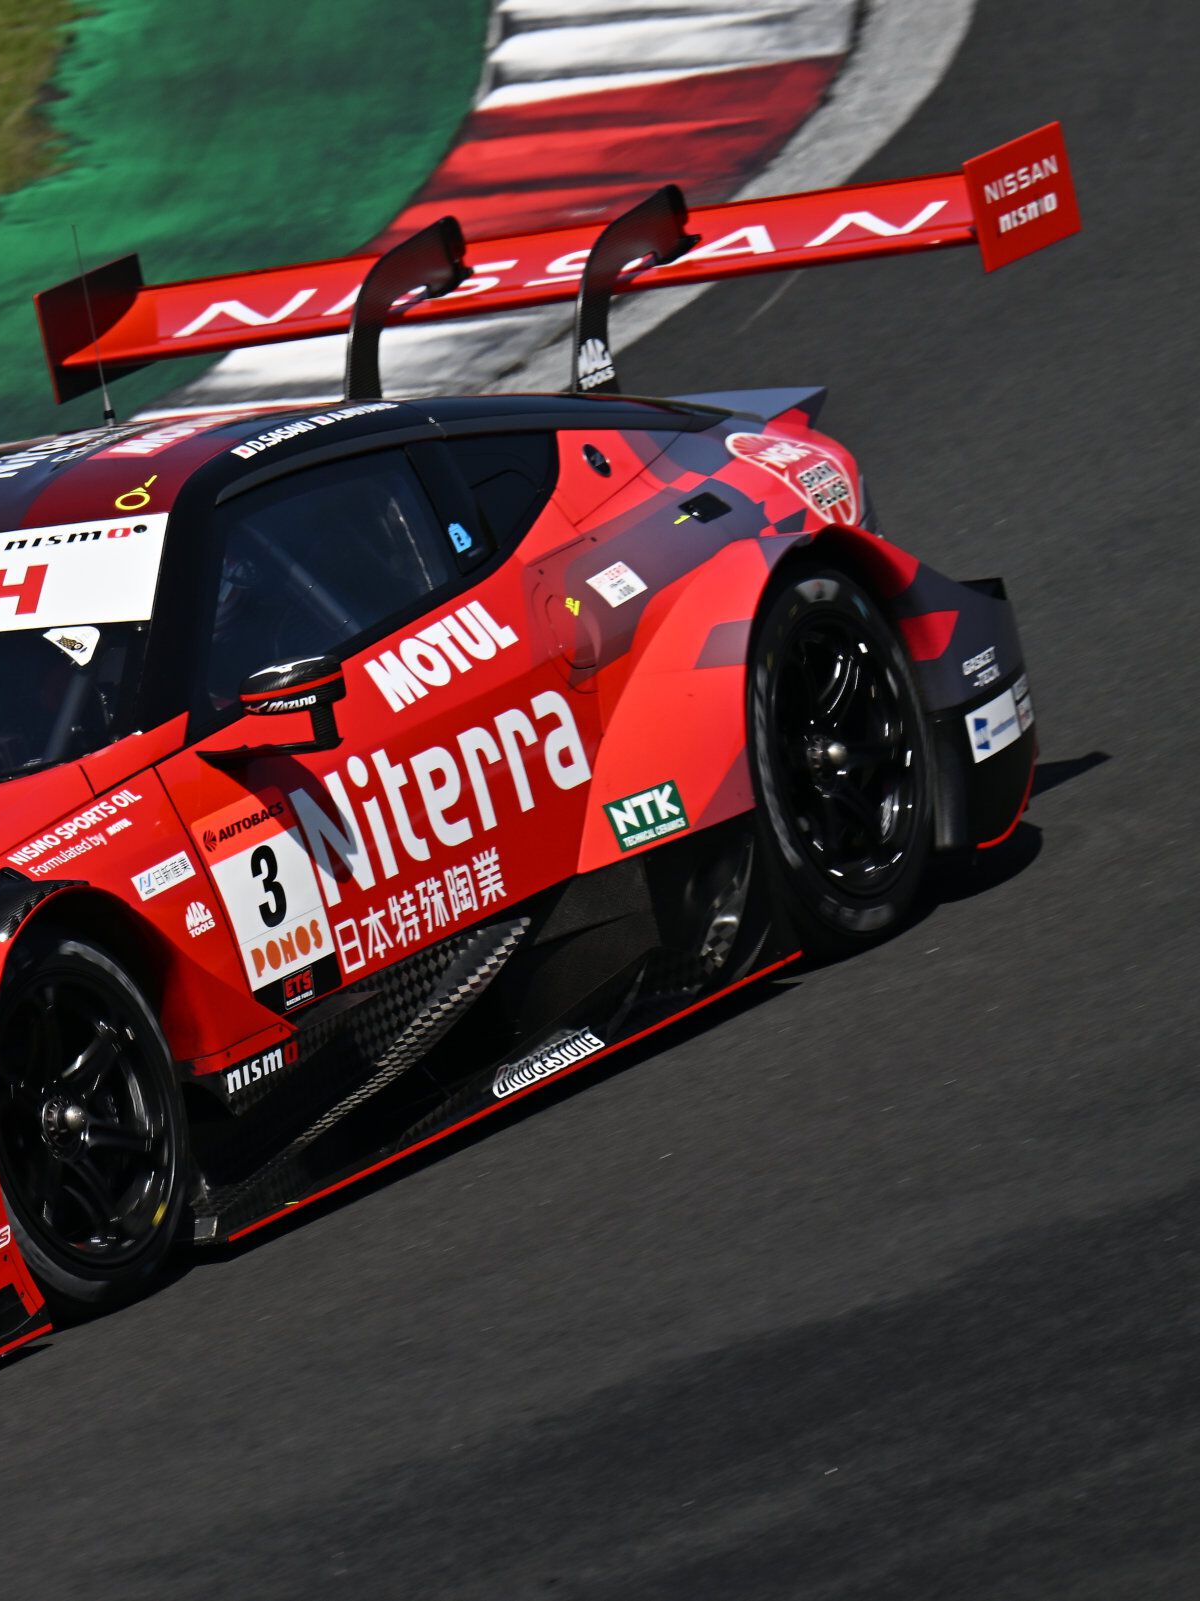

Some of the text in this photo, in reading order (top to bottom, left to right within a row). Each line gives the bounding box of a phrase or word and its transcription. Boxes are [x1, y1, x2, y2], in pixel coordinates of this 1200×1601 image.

[984, 154, 1059, 205] NISSAN
[4, 526, 132, 551] nismo
[362, 600, 520, 713] MOTUL
[218, 801, 285, 843] AUTOBACS
[289, 690, 592, 908] Niterra
[609, 784, 681, 835] NTK
[7, 789, 143, 866] NISMO SPORTS OIL
[28, 838, 92, 877] Formulated
[90, 832, 108, 851] by
[250, 845, 288, 928] 3
[334, 847, 508, 975] 日本特殊陶業
[189, 918, 216, 938] TOOLS
[250, 919, 323, 978] PONOS
[226, 1040, 299, 1094] nismo
